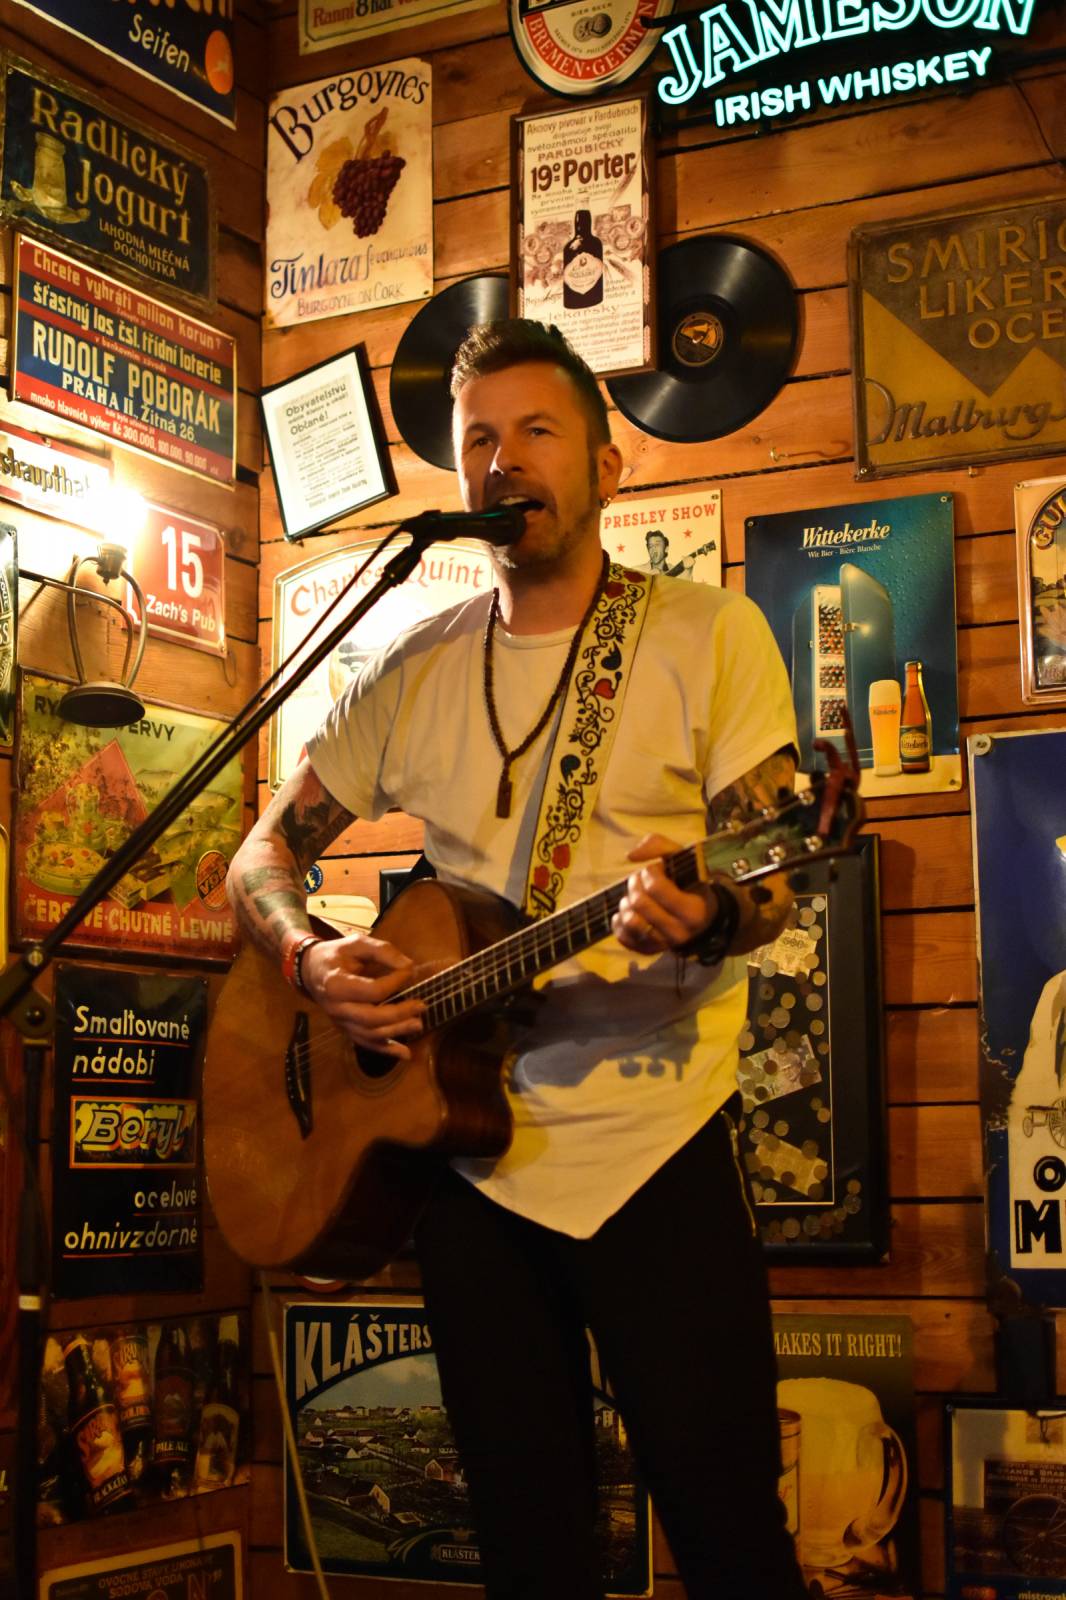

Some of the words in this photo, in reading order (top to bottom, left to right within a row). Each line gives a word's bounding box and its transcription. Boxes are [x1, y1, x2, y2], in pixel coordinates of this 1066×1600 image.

[129, 13, 191, 73] Seifen
[529, 15, 586, 77] BREMEN
[658, 0, 1035, 105] JAMESON
[715, 81, 810, 127] IRISH
[819, 46, 992, 105] WHISKEY
[268, 69, 430, 164] Burgoynes
[32, 87, 188, 206] Radlický
[563, 152, 636, 188] Porter
[76, 159, 191, 245] Jogurt
[99, 217, 146, 252] LAHODNÁ
[148, 242, 191, 272] MLÉČNÁ
[113, 240, 177, 280] POCHOUTKA
[33, 248, 80, 286] Chcete
[85, 277, 132, 311] vyhráti
[137, 302, 174, 331] milion
[33, 281, 89, 331] šťastný
[93, 307, 114, 337] los
[118, 320, 140, 349] čsl.
[142, 331, 177, 366] třídní
[179, 346, 222, 384] loterie
[30, 392, 56, 410] mnoho
[33, 320, 116, 387] RUDOLF
[127, 363, 220, 435] POBORÁK
[62, 371, 119, 411] PRAHA
[141, 403, 176, 436] Žitná
[180, 422, 197, 444] 26.
[604, 509, 667, 529] PRESLEY
[672, 503, 717, 521] SHOW
[803, 519, 890, 548] Wittekerke
[161, 525, 204, 599] 15
[821, 548, 833, 558] Bier
[146, 593, 188, 624] Zach's
[192, 608, 216, 633] Pub
[23, 894, 103, 929] ČERSVÉ
[107, 907, 172, 937] CHUTNÉ
[180, 914, 233, 943] LEVNÉ
[74, 1005, 190, 1040] Smaltované
[80, 1108, 184, 1157] Beryl
[134, 1180, 197, 1210] ocelové
[64, 1218, 198, 1250] ohnivzdorné
[827, 1333, 842, 1357] IT
[847, 1333, 903, 1358] RIGHT!
